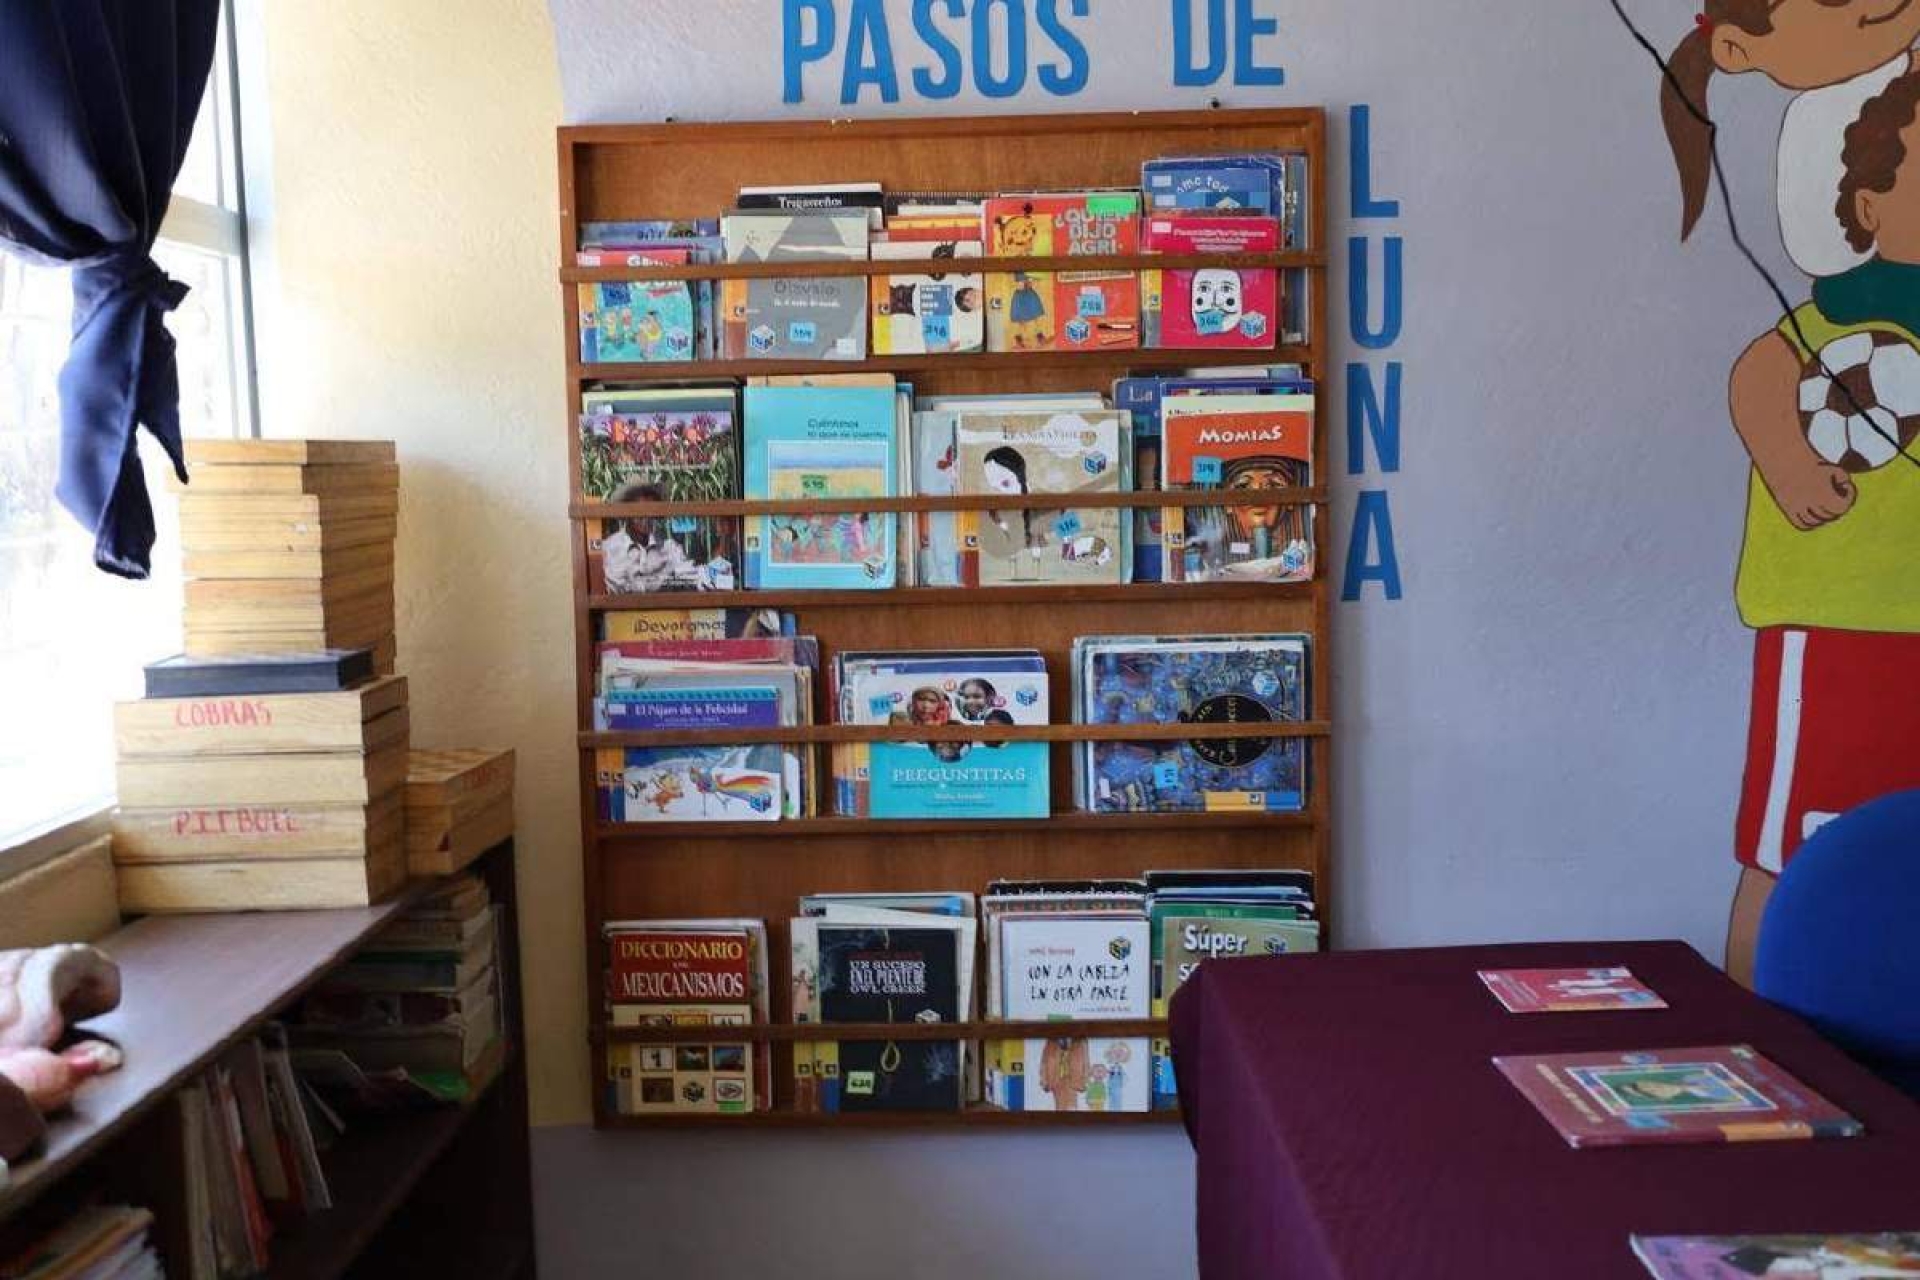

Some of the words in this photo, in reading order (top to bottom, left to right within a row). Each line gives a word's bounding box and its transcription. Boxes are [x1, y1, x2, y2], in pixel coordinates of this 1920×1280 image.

[782, 0, 1089, 105] PASOS
[1173, 0, 1285, 88] DE
[1069, 221, 1117, 238] DIJO
[1342, 104, 1404, 602] LUNA
[174, 700, 272, 728] COBRAS
[892, 766, 1026, 782] PREGUNTITAS
[621, 941, 743, 960] DICCIONARIO
[1183, 924, 1249, 958] Súper
[623, 971, 745, 998] MEXICANISMOS
